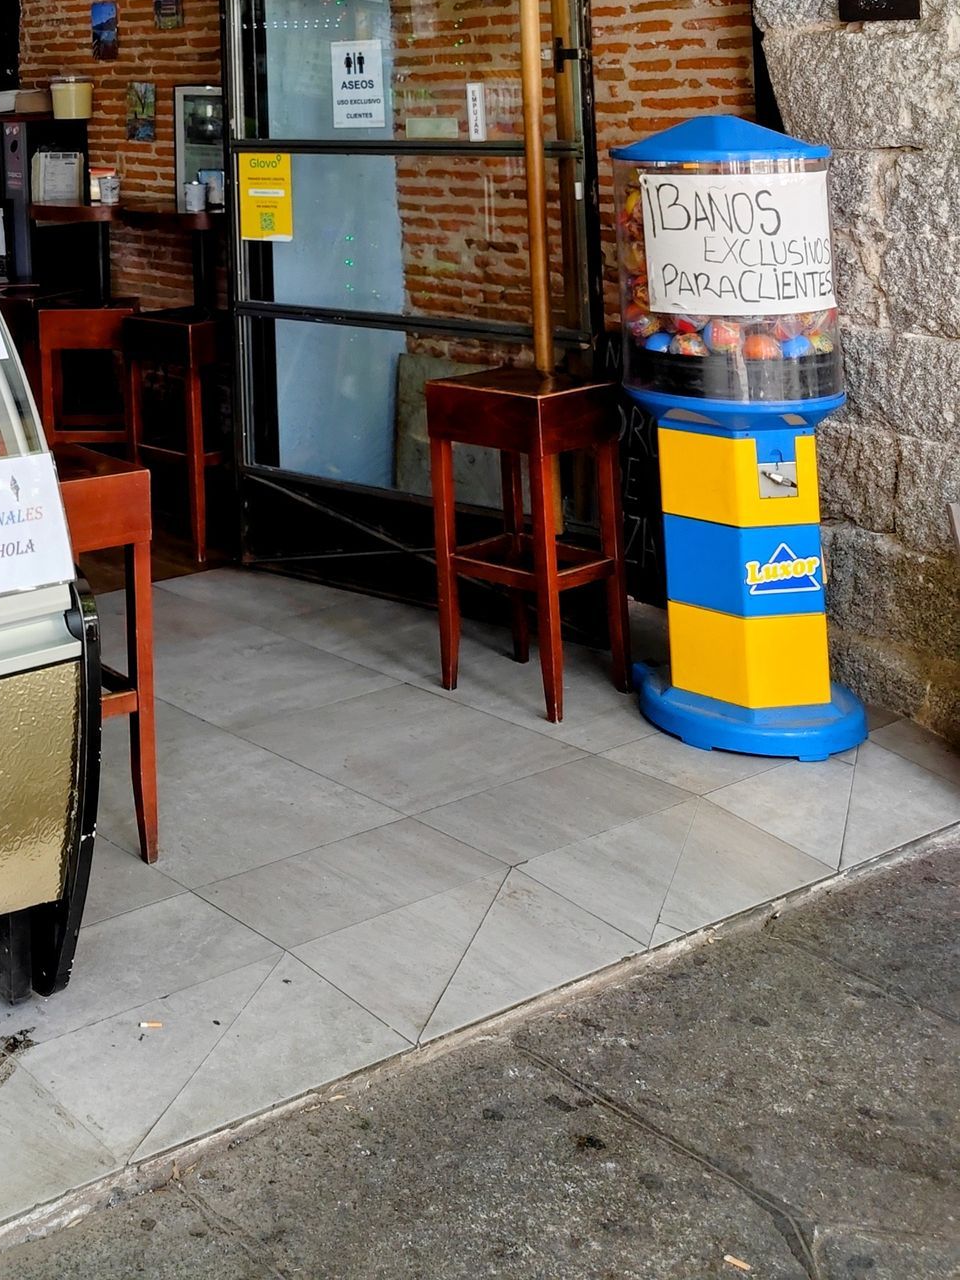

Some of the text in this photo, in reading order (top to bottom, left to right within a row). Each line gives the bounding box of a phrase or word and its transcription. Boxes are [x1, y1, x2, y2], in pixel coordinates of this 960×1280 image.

[341, 79, 375, 90] ASEOS
[471, 89, 480, 135] EMPUJAR
[249, 157, 278, 169] Glovo
[704, 236, 831, 267] EXCLUSIVOS
[746, 557, 819, 585] Luxor
